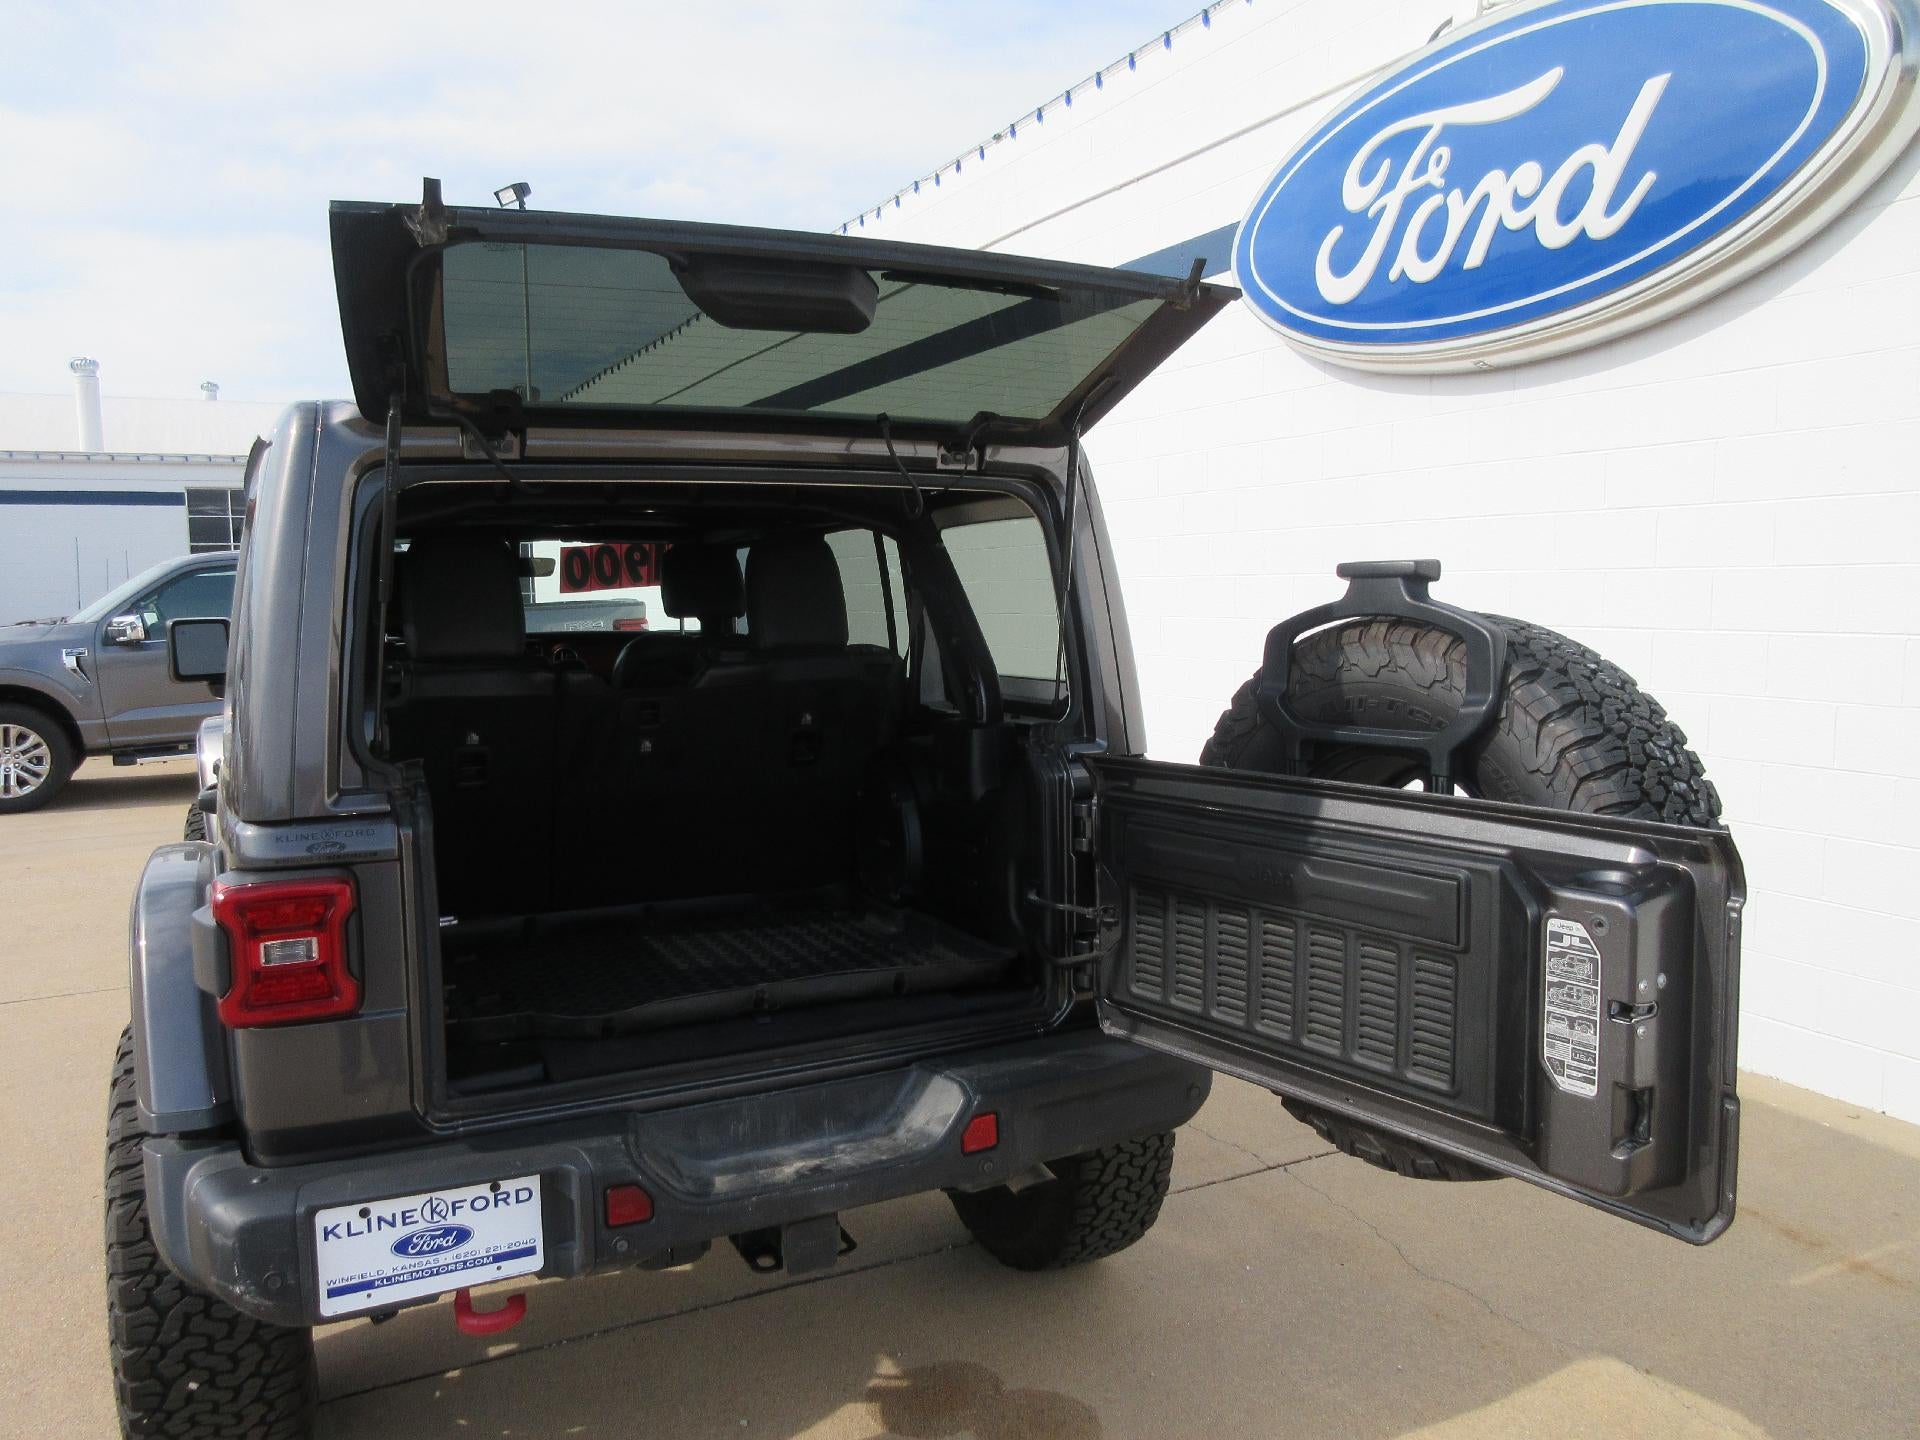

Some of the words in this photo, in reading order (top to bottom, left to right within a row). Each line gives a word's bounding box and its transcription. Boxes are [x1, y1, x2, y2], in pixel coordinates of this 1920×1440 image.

[1315, 66, 1672, 305] Ford
[274, 832, 319, 843] KLINE
[335, 829, 376, 838] FORD
[323, 1208, 419, 1242] KLINE
[451, 1186, 534, 1217] FORD
[408, 1229, 457, 1254] Ford
[326, 1269, 387, 1286] WINFIELD,
[392, 1257, 440, 1273] KANSAS
[485, 1238, 537, 1254] 221-2040
[374, 1255, 493, 1287] KLINEMOTORS.COM
